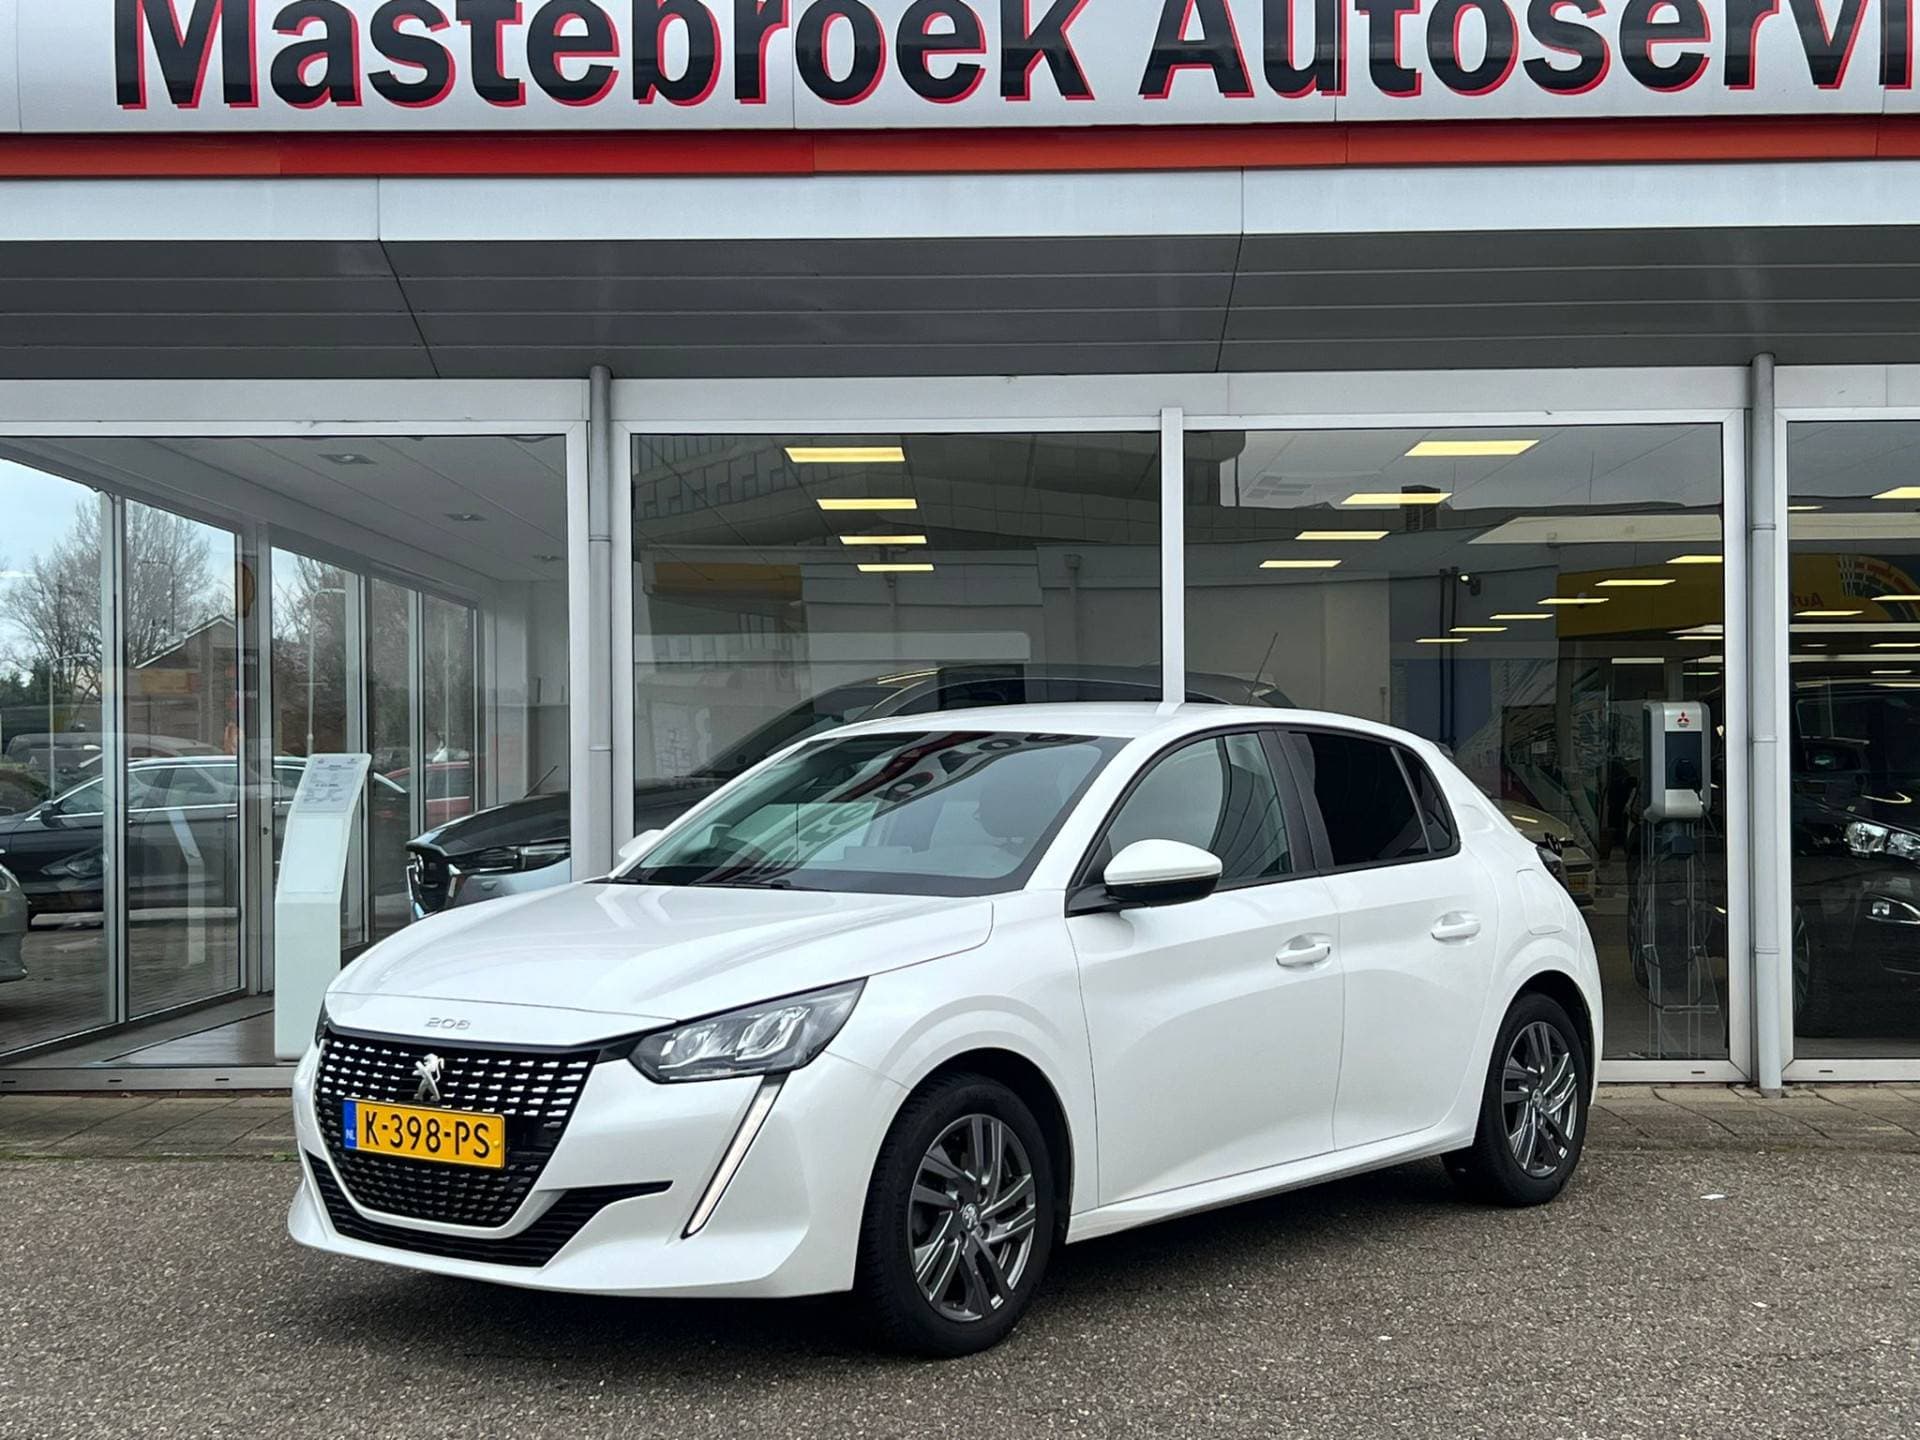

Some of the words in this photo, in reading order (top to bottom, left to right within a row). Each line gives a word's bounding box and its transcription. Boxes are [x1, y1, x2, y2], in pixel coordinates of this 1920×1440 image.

[114, 0, 1094, 108] Mastebroek
[425, 1016, 471, 1030] 208
[345, 1129, 356, 1140] NL
[365, 1110, 490, 1159] K-398-PS
